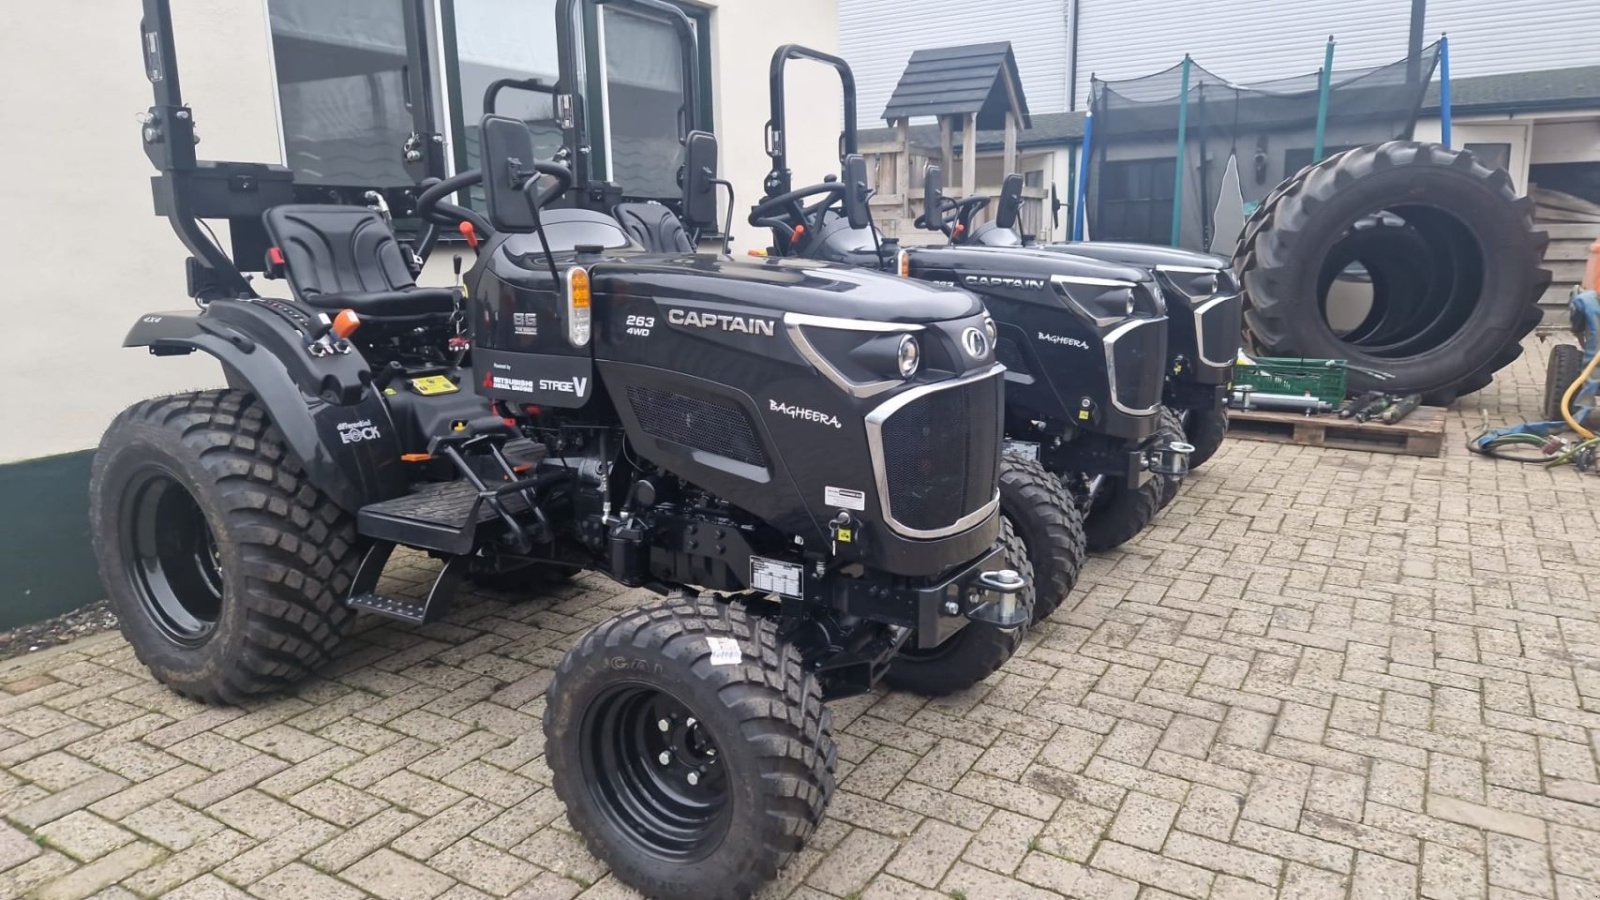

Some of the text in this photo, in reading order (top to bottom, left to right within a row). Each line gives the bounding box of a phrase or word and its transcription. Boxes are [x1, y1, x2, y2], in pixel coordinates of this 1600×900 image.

[965, 275, 1044, 289] CAPTAIN
[626, 315, 655, 328] 263
[668, 309, 775, 336] CAPTAIN
[626, 328, 650, 337] 4WD
[1038, 331, 1089, 349] BAGHEERA
[769, 399, 841, 428] BAGHEERA
